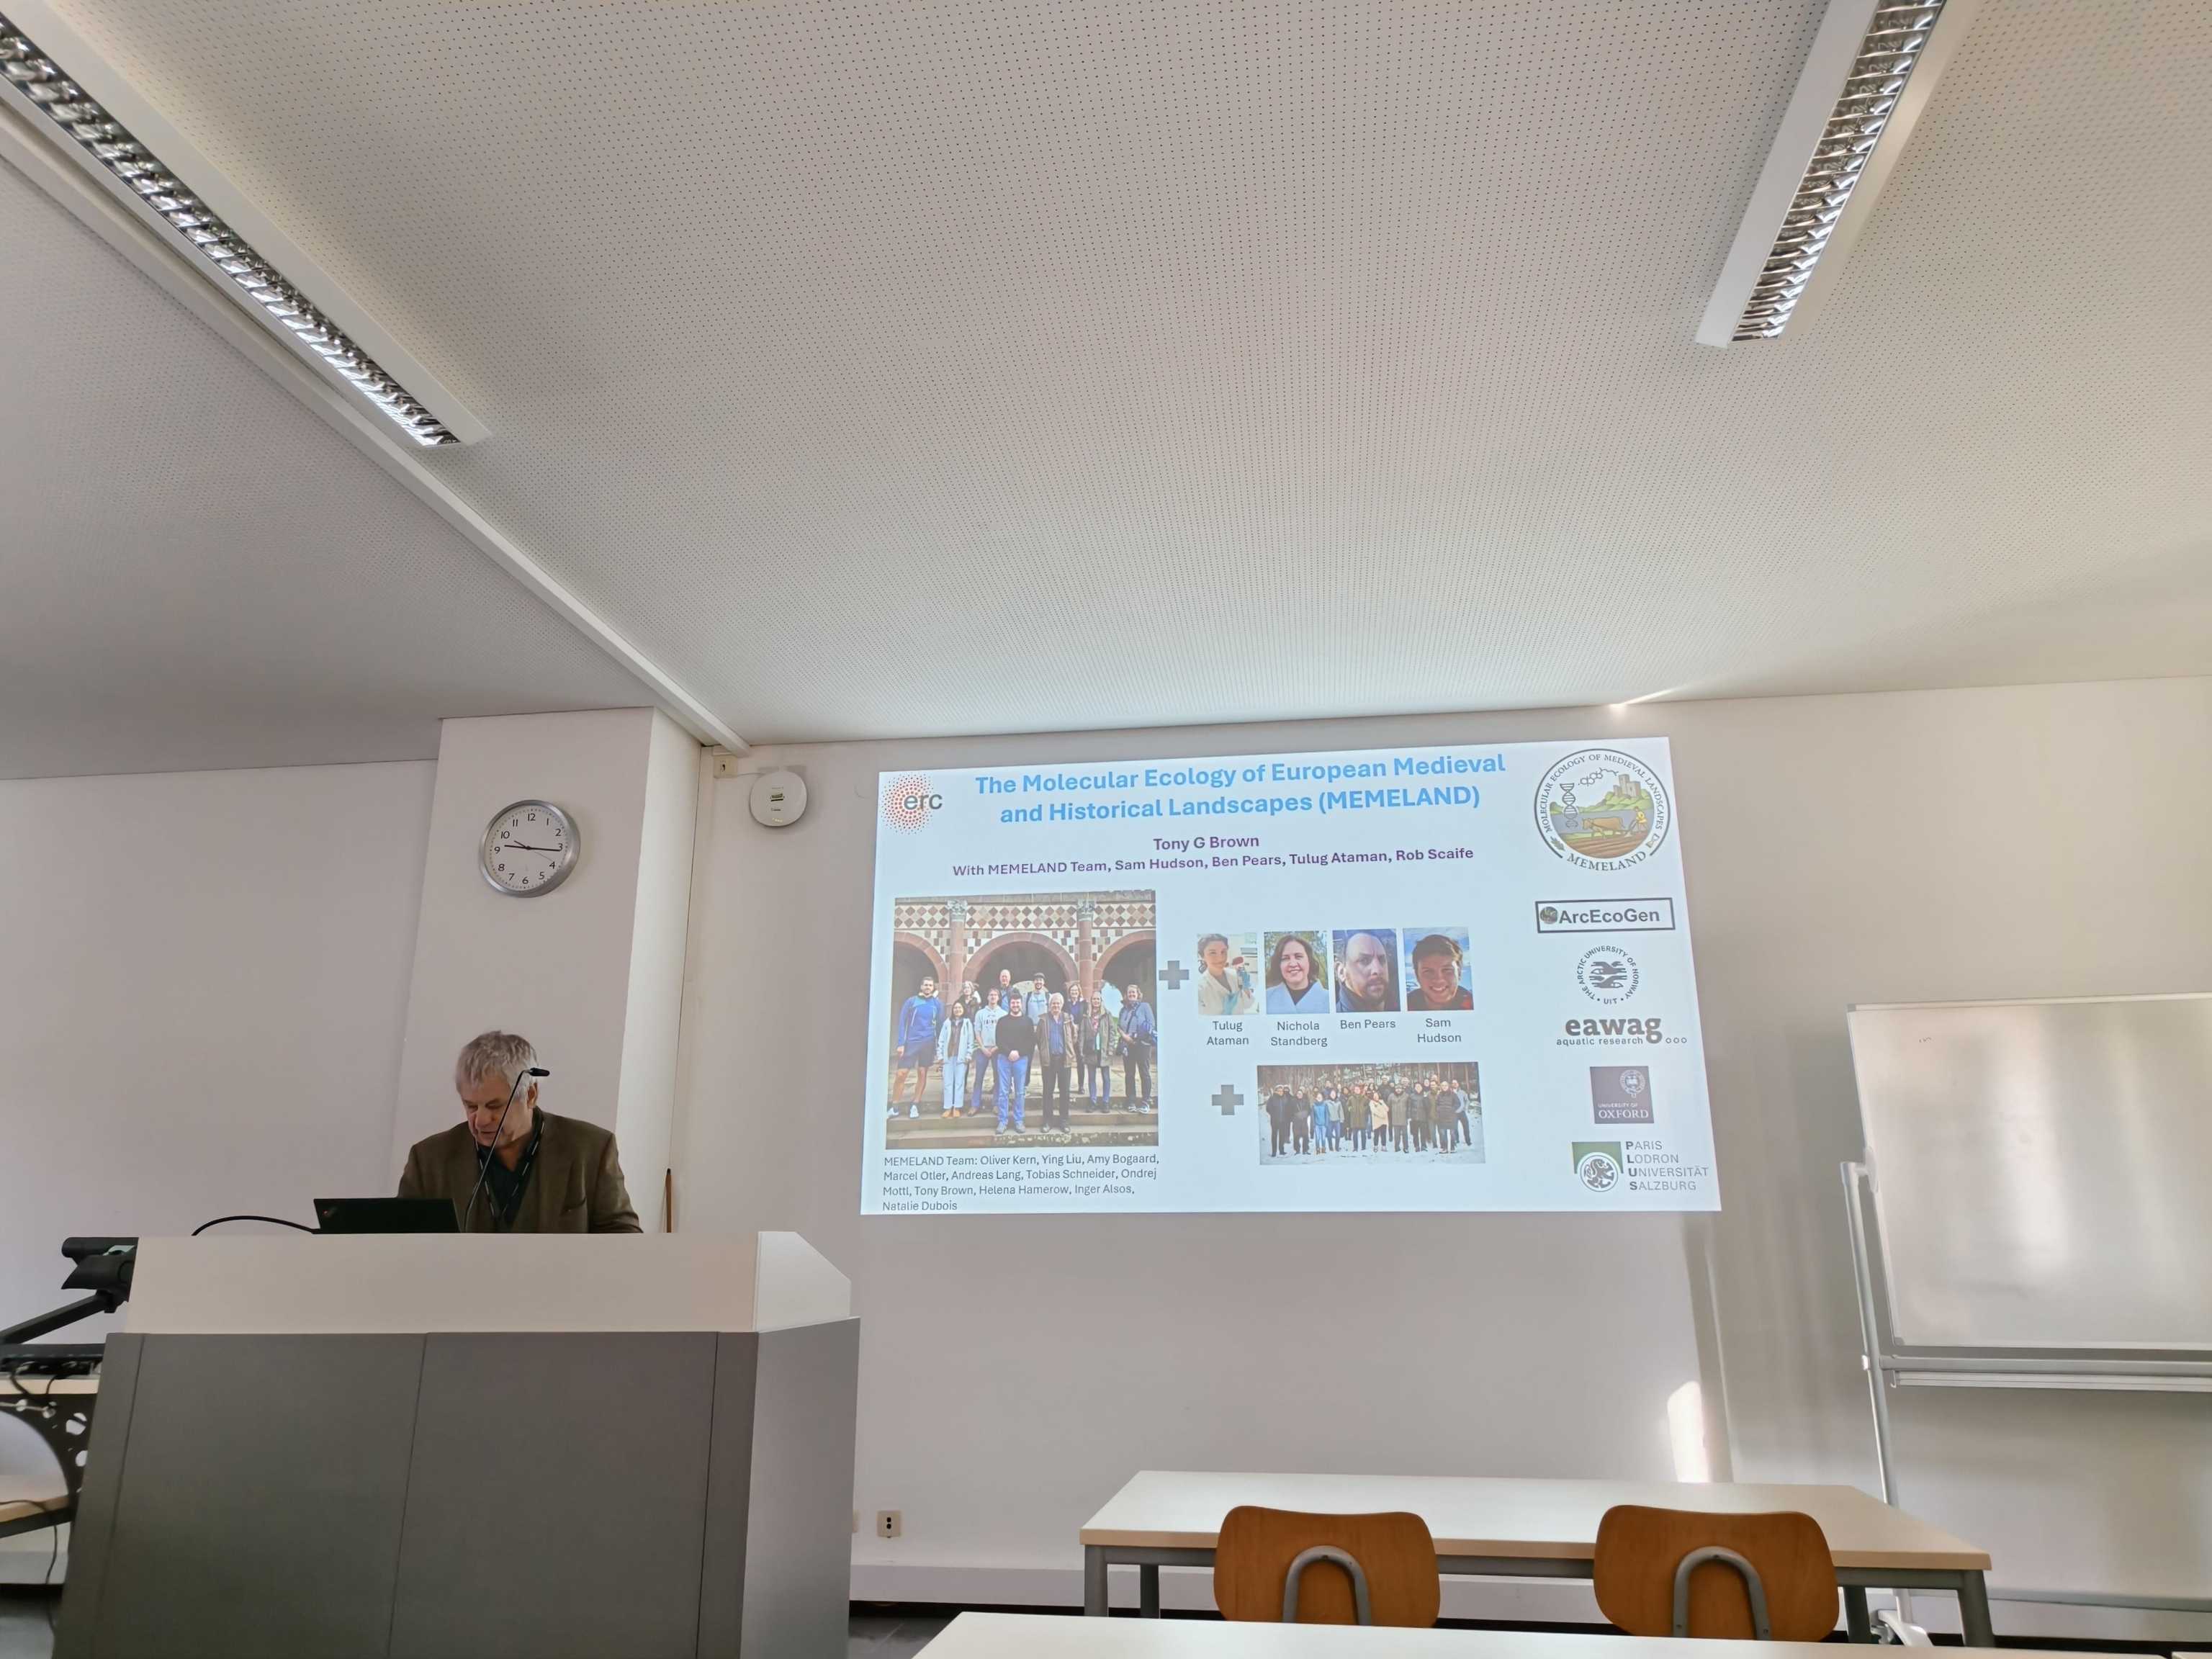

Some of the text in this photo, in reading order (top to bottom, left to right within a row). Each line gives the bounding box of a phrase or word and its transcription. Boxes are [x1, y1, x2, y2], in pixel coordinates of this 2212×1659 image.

[975, 753, 1506, 794] The Molecular Ecology of European Medieval
[1539, 782, 1554, 834] MOLECULAR
[1550, 755, 1586, 782] ECOLOGY
[1604, 754, 1646, 778] MEDIEVAL
[1645, 777, 1665, 830] LANDSCAPES
[904, 793, 943, 810] erc
[1000, 785, 1480, 823] and Historical Landscapes (MEMELAND)
[527, 813, 536, 822] 12
[500, 830, 511, 839] 10
[558, 842, 564, 852] 3
[1153, 836, 1260, 853] Tony G Brown
[953, 847, 1474, 876] With MEMELAND Team, Sam Hudson, Ben Pears, Tulug Ataman, Rob Scaife
[1567, 850, 1647, 871] MEMELAND
[539, 871, 545, 880] 5
[1558, 908, 1660, 925] ArcEcoGen
[1577, 945, 1640, 1000] THE ARCTIC UNIVERSITY OF NORWAY
[1213, 1020, 1243, 1032] Tulug
[1277, 1020, 1320, 1031] Nichola
[1340, 1019, 1396, 1030] Ben Pears
[1425, 1017, 1452, 1028] Sam
[1565, 1018, 1663, 1044] eawag
[1206, 1036, 1249, 1046] Ataman
[1270, 1036, 1328, 1048] Standberg
[1417, 1033, 1462, 1043] Hudson
[1556, 1036, 1643, 1047] aquatic research
[1599, 1109, 1649, 1119] OXFORD
[1625, 1141, 1663, 1151] PARIS
[884, 1154, 1160, 1166] MEMELAND Team: Oliver Kern, Ying Liu, Amy Bogaard,
[1627, 1154, 1679, 1164] LODRON
[884, 1171, 918, 1181] Marcel
[951, 1170, 994, 1180] Andreas
[996, 1169, 1024, 1182] Lang,
[1025, 1169, 1061, 1179] Tobias
[1062, 1168, 1119, 1180] Schneider,
[1120, 1168, 1157, 1181] Ondrej
[882, 1183, 1135, 1197] Mottl, Tony Brown, Helena Hamerow, Inger Alsos,
[1629, 1180, 1696, 1190] SALZBURG
[882, 1200, 958, 1211] Natalie Dubois
